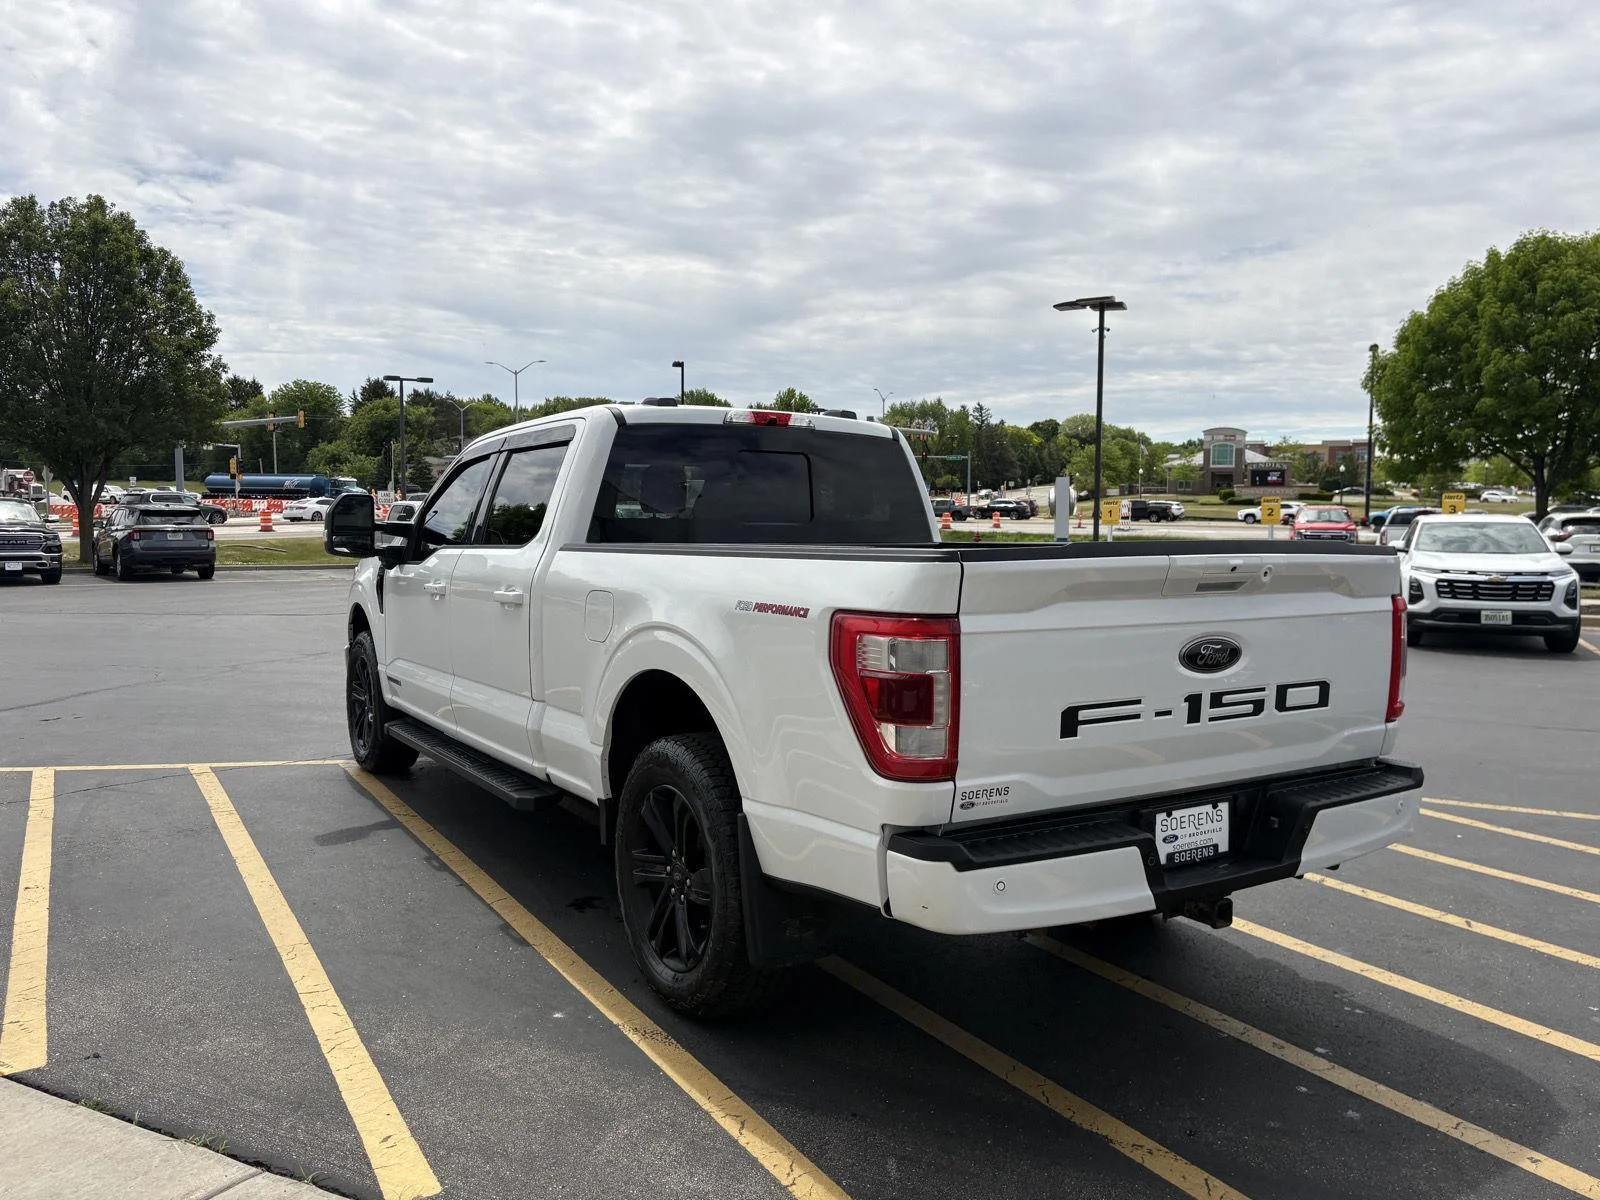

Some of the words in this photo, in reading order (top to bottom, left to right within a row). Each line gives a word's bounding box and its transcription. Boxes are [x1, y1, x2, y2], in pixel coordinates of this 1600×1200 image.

[1107, 509, 1113, 518] 1
[1266, 507, 1274, 517] 2
[1448, 504, 1457, 514] 3
[753, 602, 810, 618] PERFORMANCE
[1197, 644, 1230, 666] Ford
[1060, 680, 1331, 739] F-150
[960, 786, 1010, 801] SOERENS
[1160, 808, 1223, 832] SOERENS
[1188, 827, 1223, 838] BROOKFIELD
[1172, 837, 1214, 851] soerens.com
[1174, 846, 1214, 863] SOERENS
